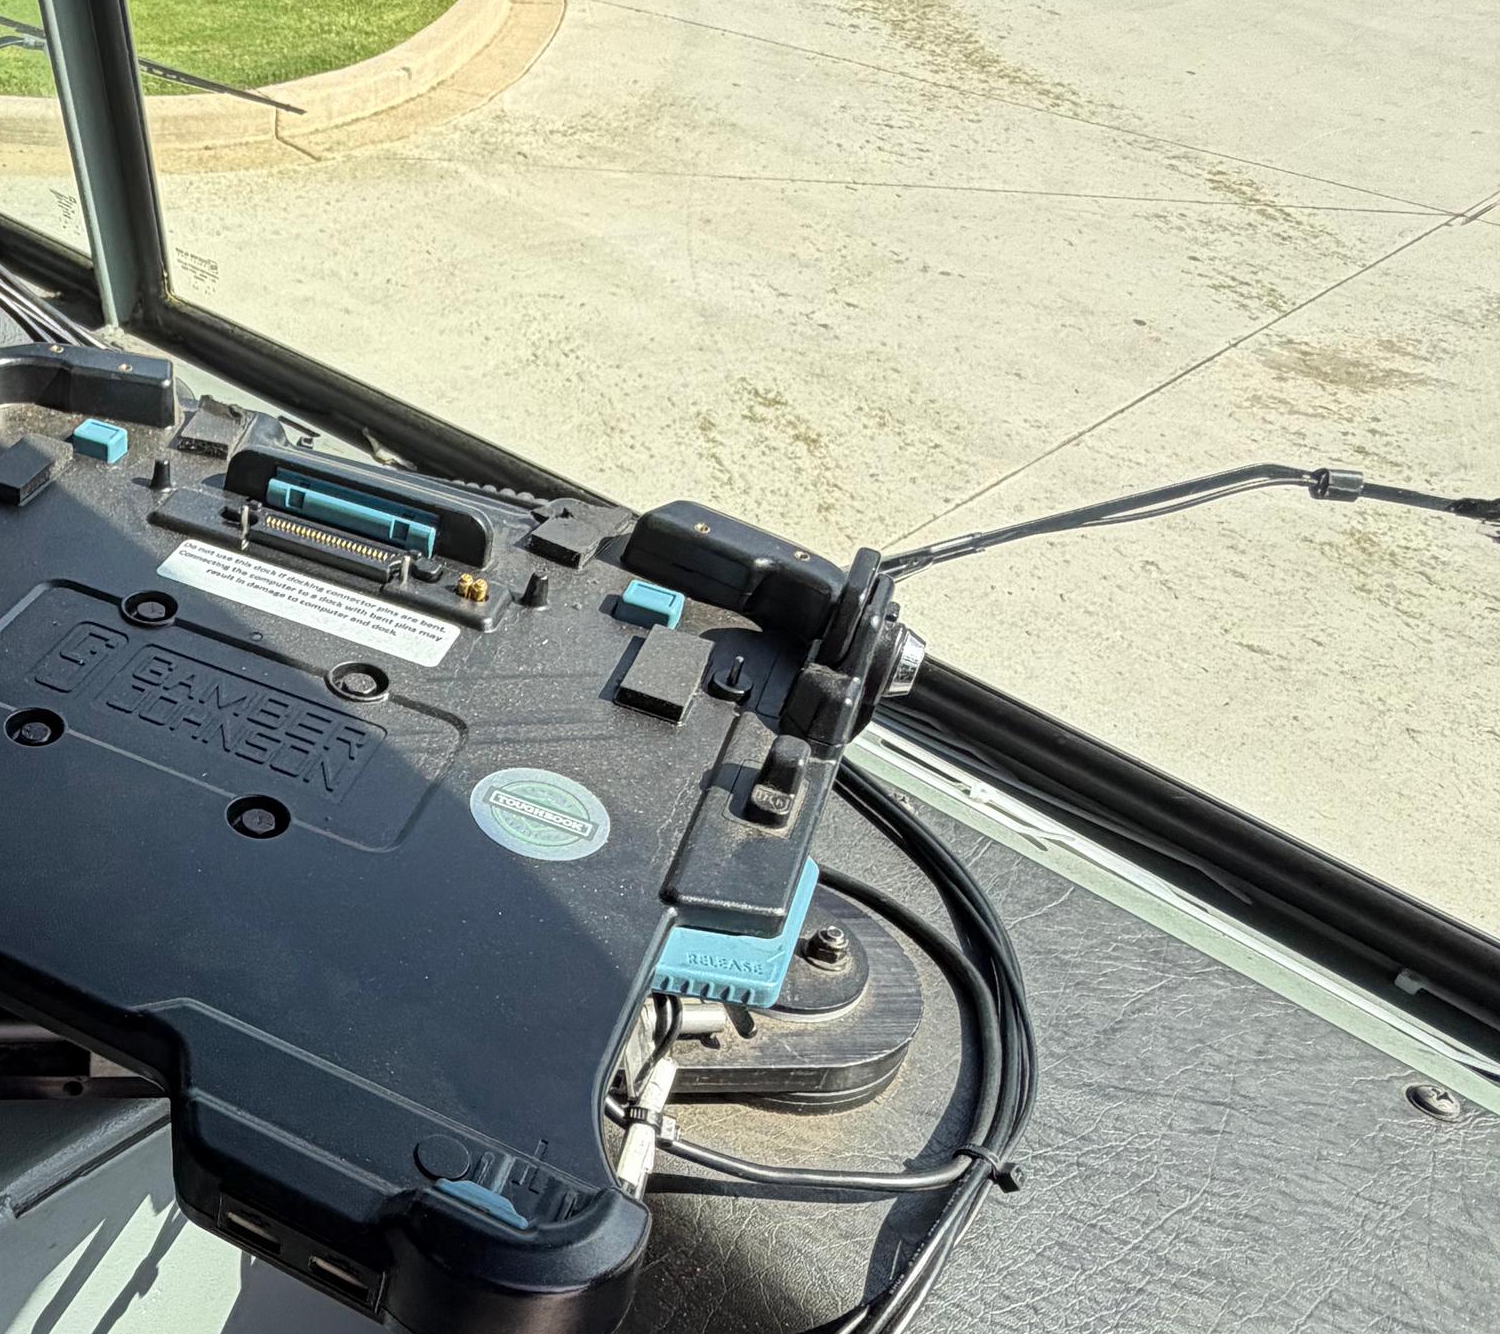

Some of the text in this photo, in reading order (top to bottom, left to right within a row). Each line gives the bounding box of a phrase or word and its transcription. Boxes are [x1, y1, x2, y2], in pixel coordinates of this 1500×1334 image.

[176, 549, 231, 571] Connecting
[229, 566, 249, 577] the
[246, 572, 297, 594] computer
[296, 588, 309, 597] to
[317, 595, 344, 608] dock
[342, 603, 369, 617] with
[367, 612, 395, 625] bent
[392, 620, 418, 634] pins
[416, 629, 443, 642] may
[183, 541, 198, 550] Do
[196, 546, 215, 556] not
[214, 552, 232, 561] use
[232, 558, 253, 568] this
[252, 564, 278, 576] dock
[285, 575, 326, 593] docking
[324, 588, 377, 609] connector
[375, 605, 400, 618] pins
[399, 613, 419, 623] are
[417, 619, 449, 633] bent.
[204, 567, 235, 581] result
[234, 577, 247, 585] in
[244, 580, 286, 599] damage
[285, 594, 300, 603] to
[297, 598, 350, 620] computer
[348, 615, 371, 627] and
[106, 683, 350, 792] JOHNSON
[132, 655, 367, 761] BAMBER
[497, 795, 584, 831] TOUGHBOOK
[687, 953, 764, 976] RELEASE
